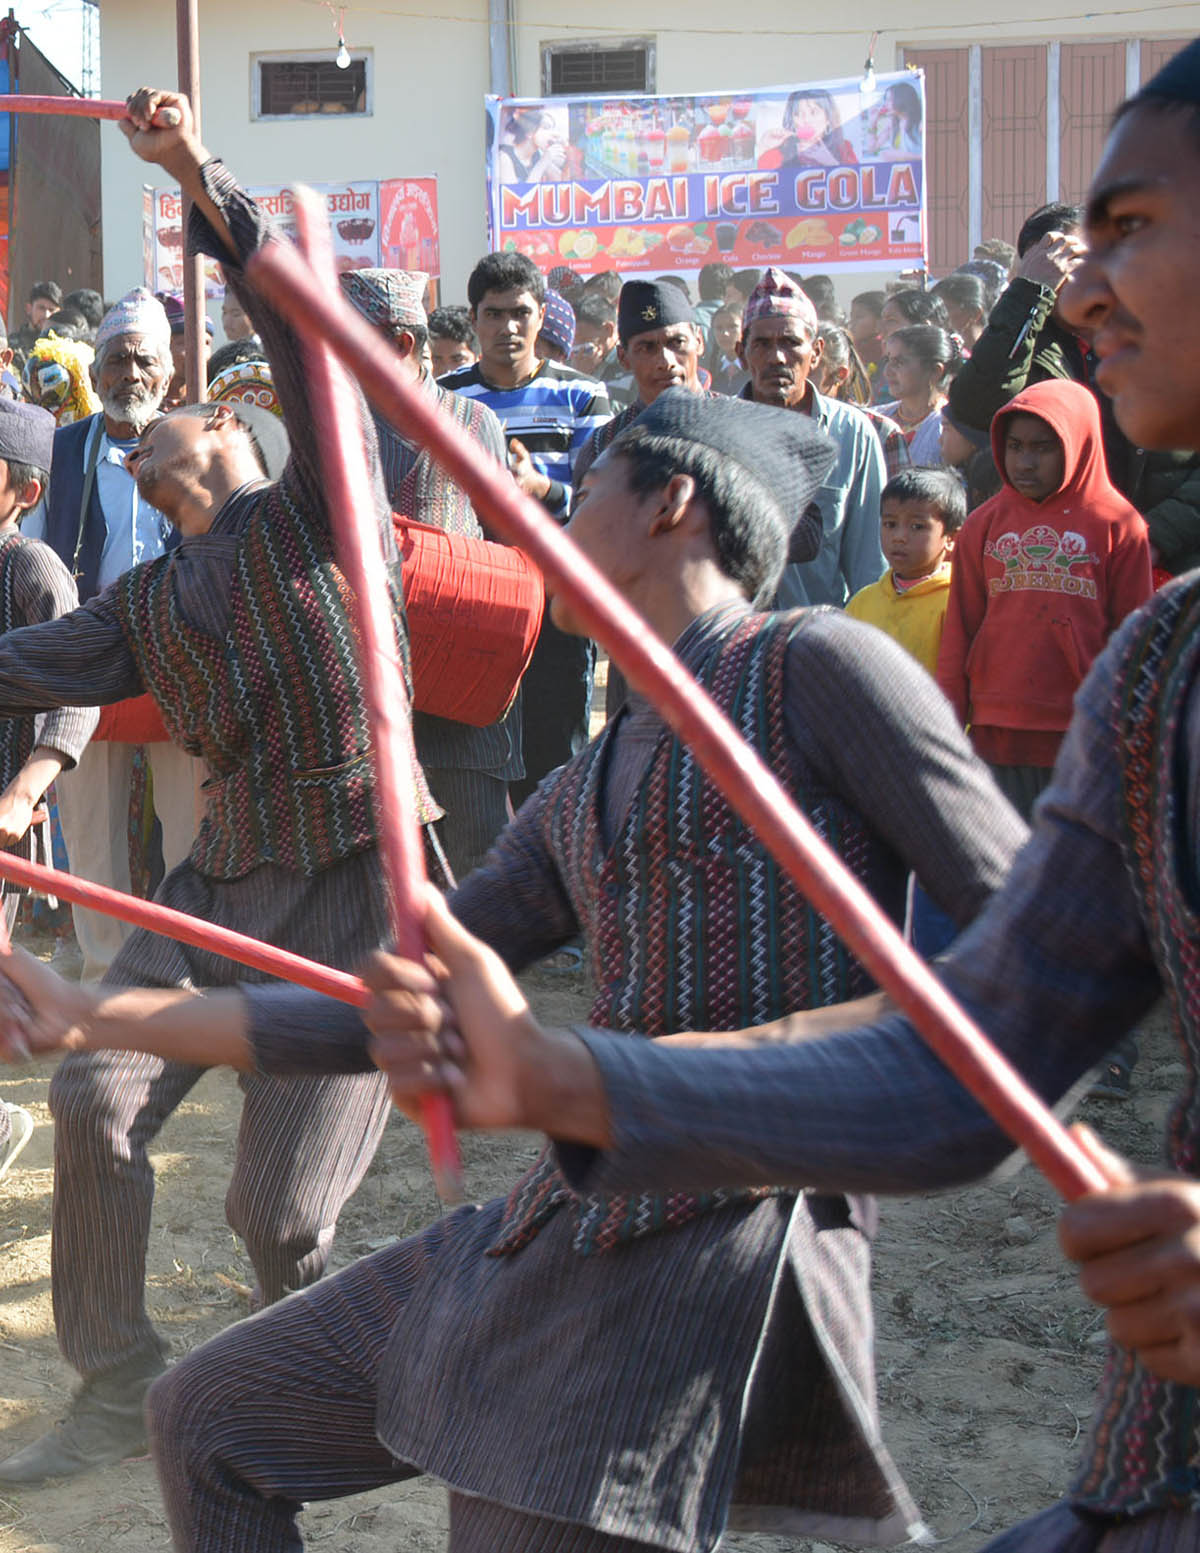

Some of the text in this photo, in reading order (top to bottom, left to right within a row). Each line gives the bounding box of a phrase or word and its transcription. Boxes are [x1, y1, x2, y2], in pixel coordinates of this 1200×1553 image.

[501, 163, 921, 228] MUMBAI ICE GOLA
[675, 256, 700, 267] Orange
